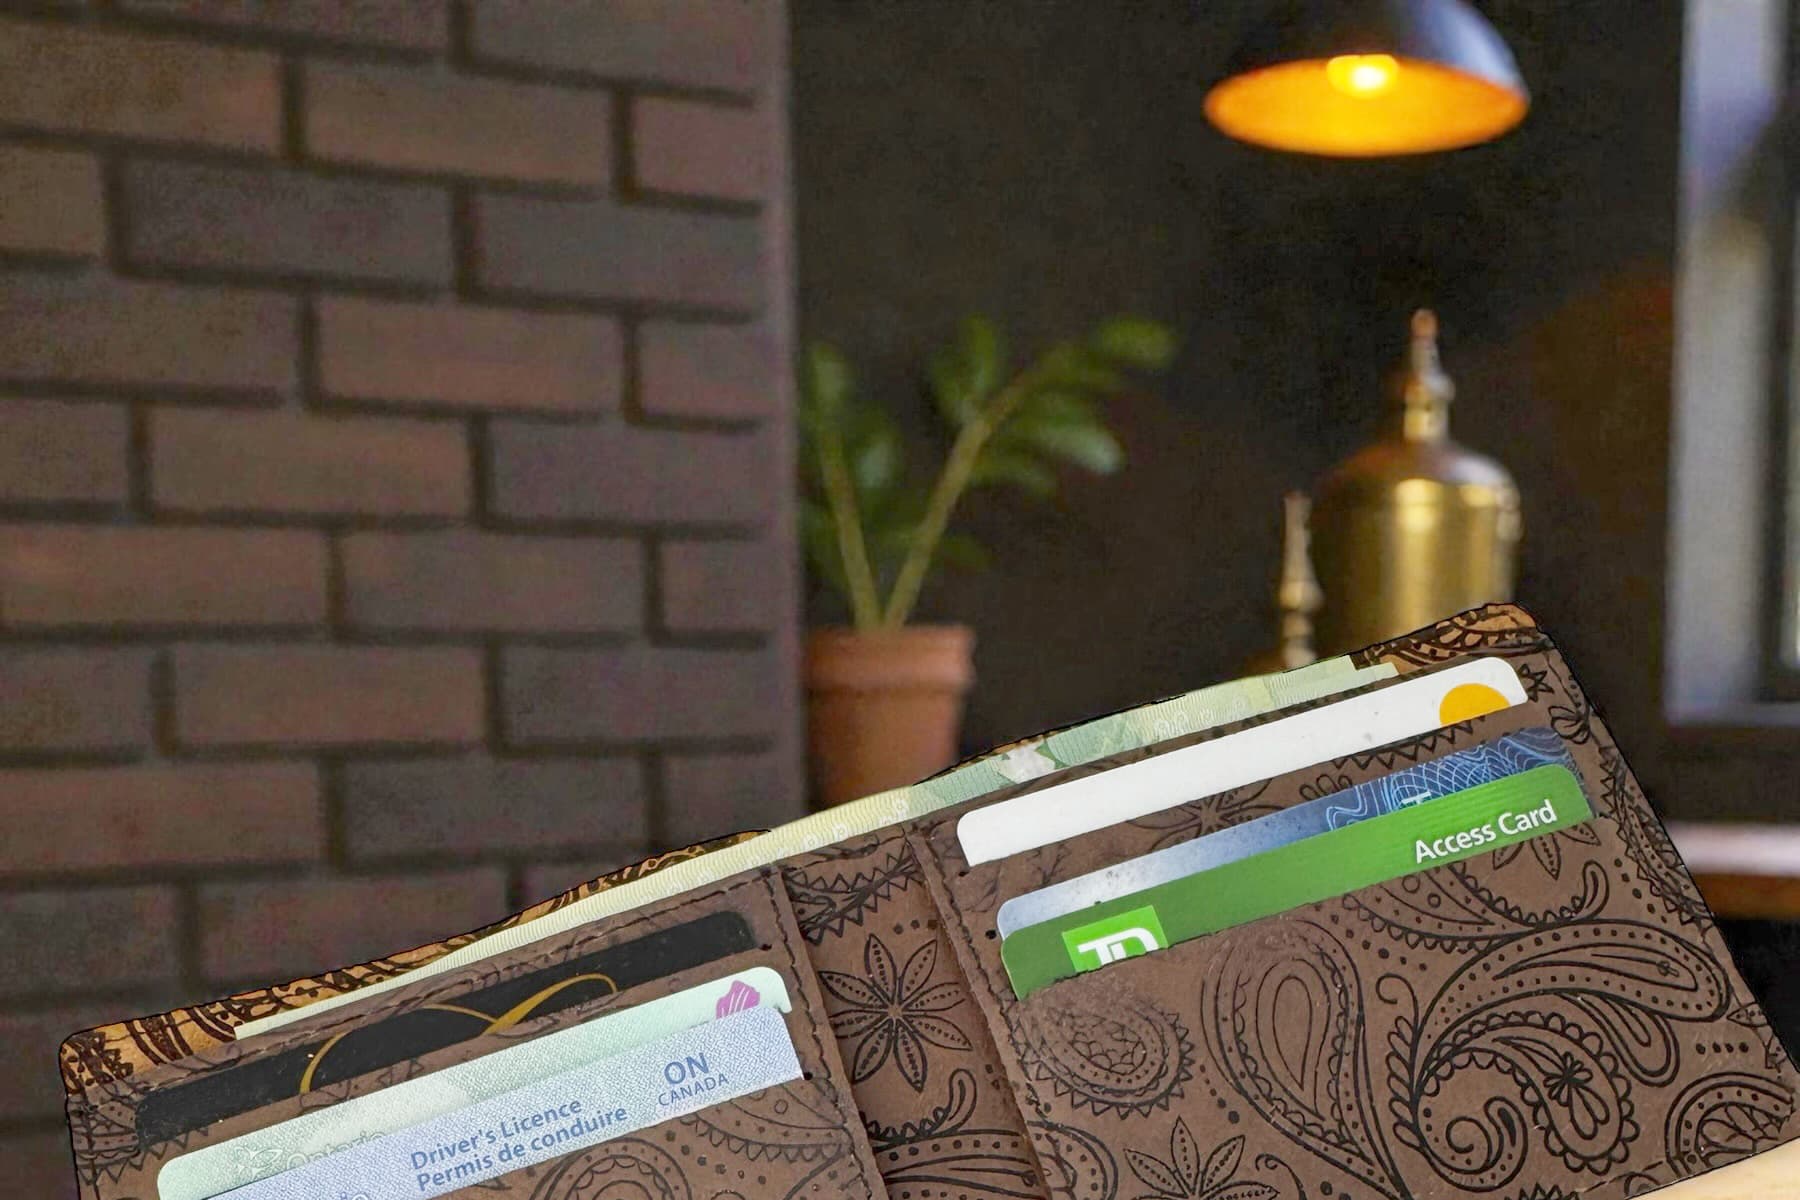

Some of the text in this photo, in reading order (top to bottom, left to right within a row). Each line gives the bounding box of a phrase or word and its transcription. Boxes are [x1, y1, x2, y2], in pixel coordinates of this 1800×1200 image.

[1415, 799, 1558, 864] Access Card
[658, 1073, 730, 1106] CANADA
[664, 1052, 710, 1085] ON
[410, 1129, 497, 1170] Driver's
[500, 1100, 583, 1138] Licence
[416, 1107, 629, 1191] Permis de conduire
